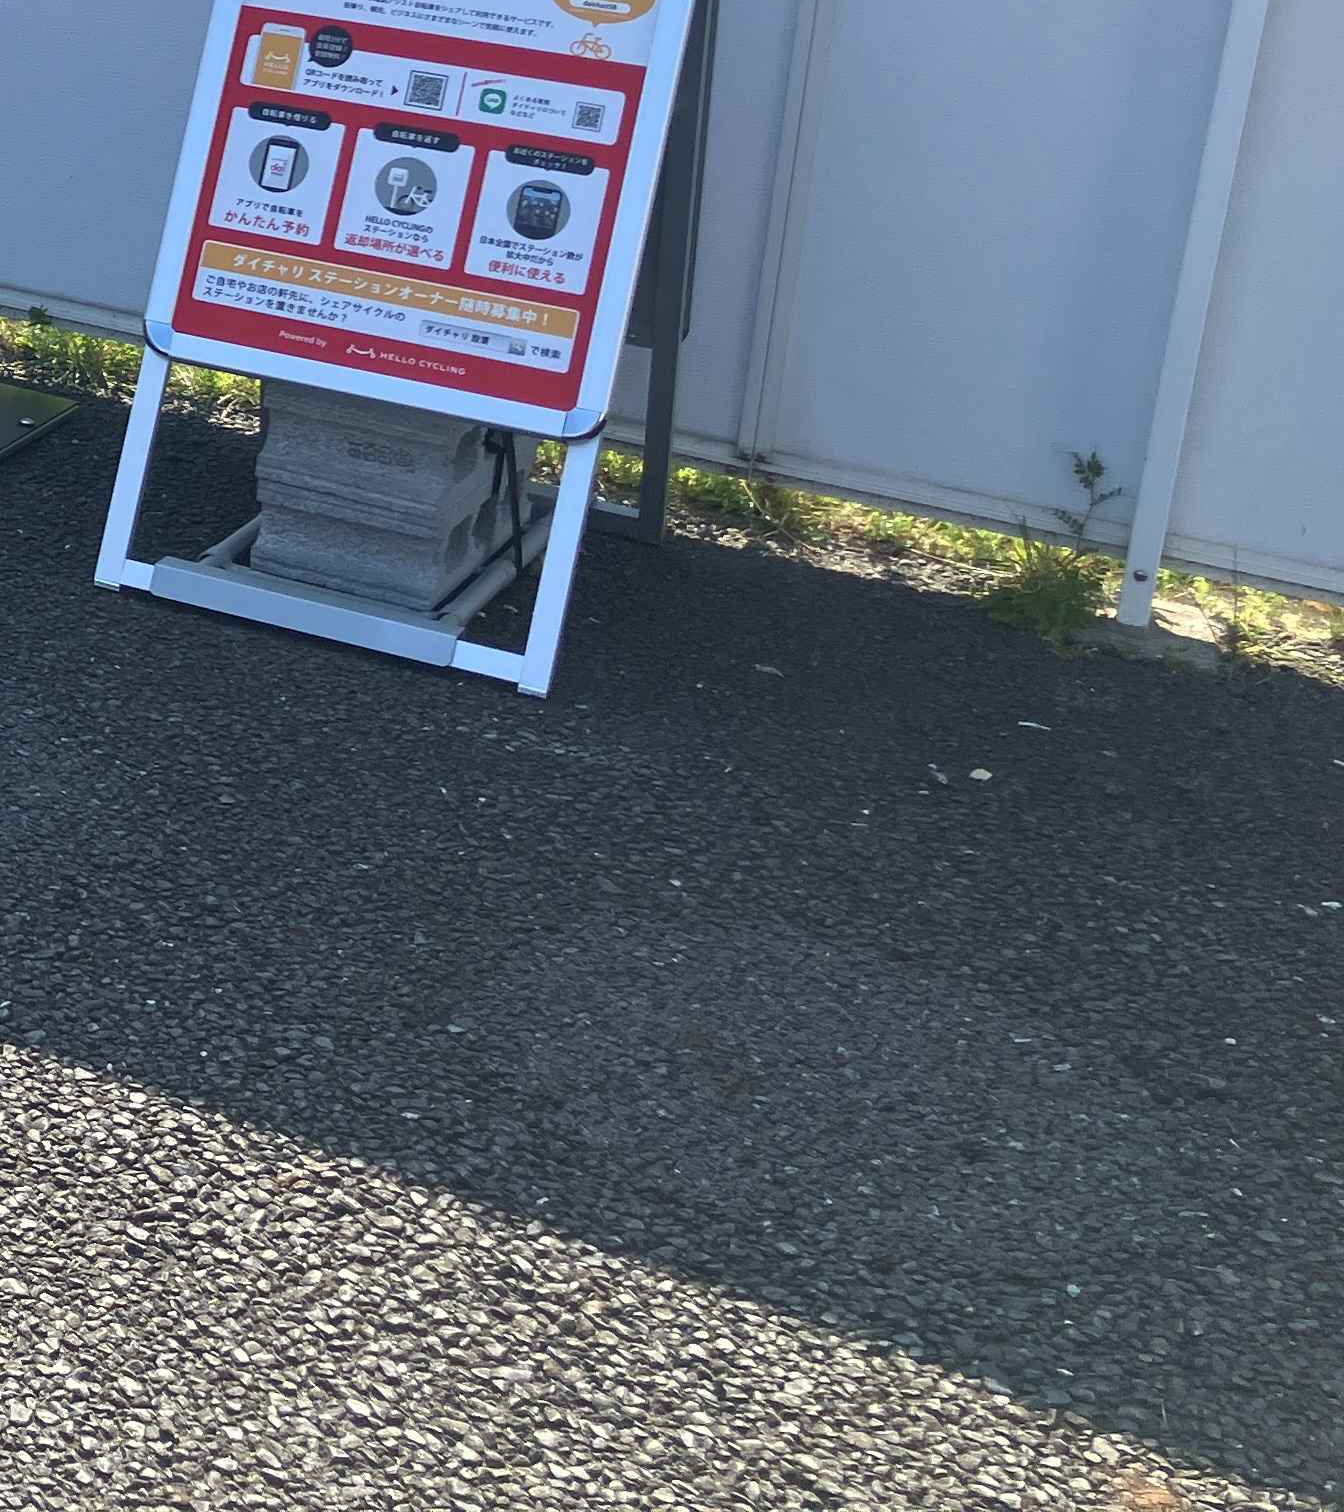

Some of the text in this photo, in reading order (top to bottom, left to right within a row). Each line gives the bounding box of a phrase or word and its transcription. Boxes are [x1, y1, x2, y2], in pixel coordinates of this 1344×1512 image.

[236, 197, 304, 218] アプリで自転車を
[365, 214, 391, 227] HELLO
[224, 209, 310, 238] かんたん予約
[363, 224, 429, 244] ステーションなら
[344, 232, 445, 262] 返却場所が選べる
[479, 235, 584, 262] 日本全国でステーション数が
[232, 253, 305, 279] ダイチャリ
[488, 259, 566, 285] 便利に使える
[203, 287, 348, 323] ステーションを置きませんか？
[206, 274, 406, 322] ご自宅やお店の軒先に、シェアサイクルの
[278, 330, 328, 349] Powered by
[425, 325, 468, 341] ダイチャリ
[379, 350, 466, 376] HELLO CYCLING
[531, 344, 562, 360] で検索
